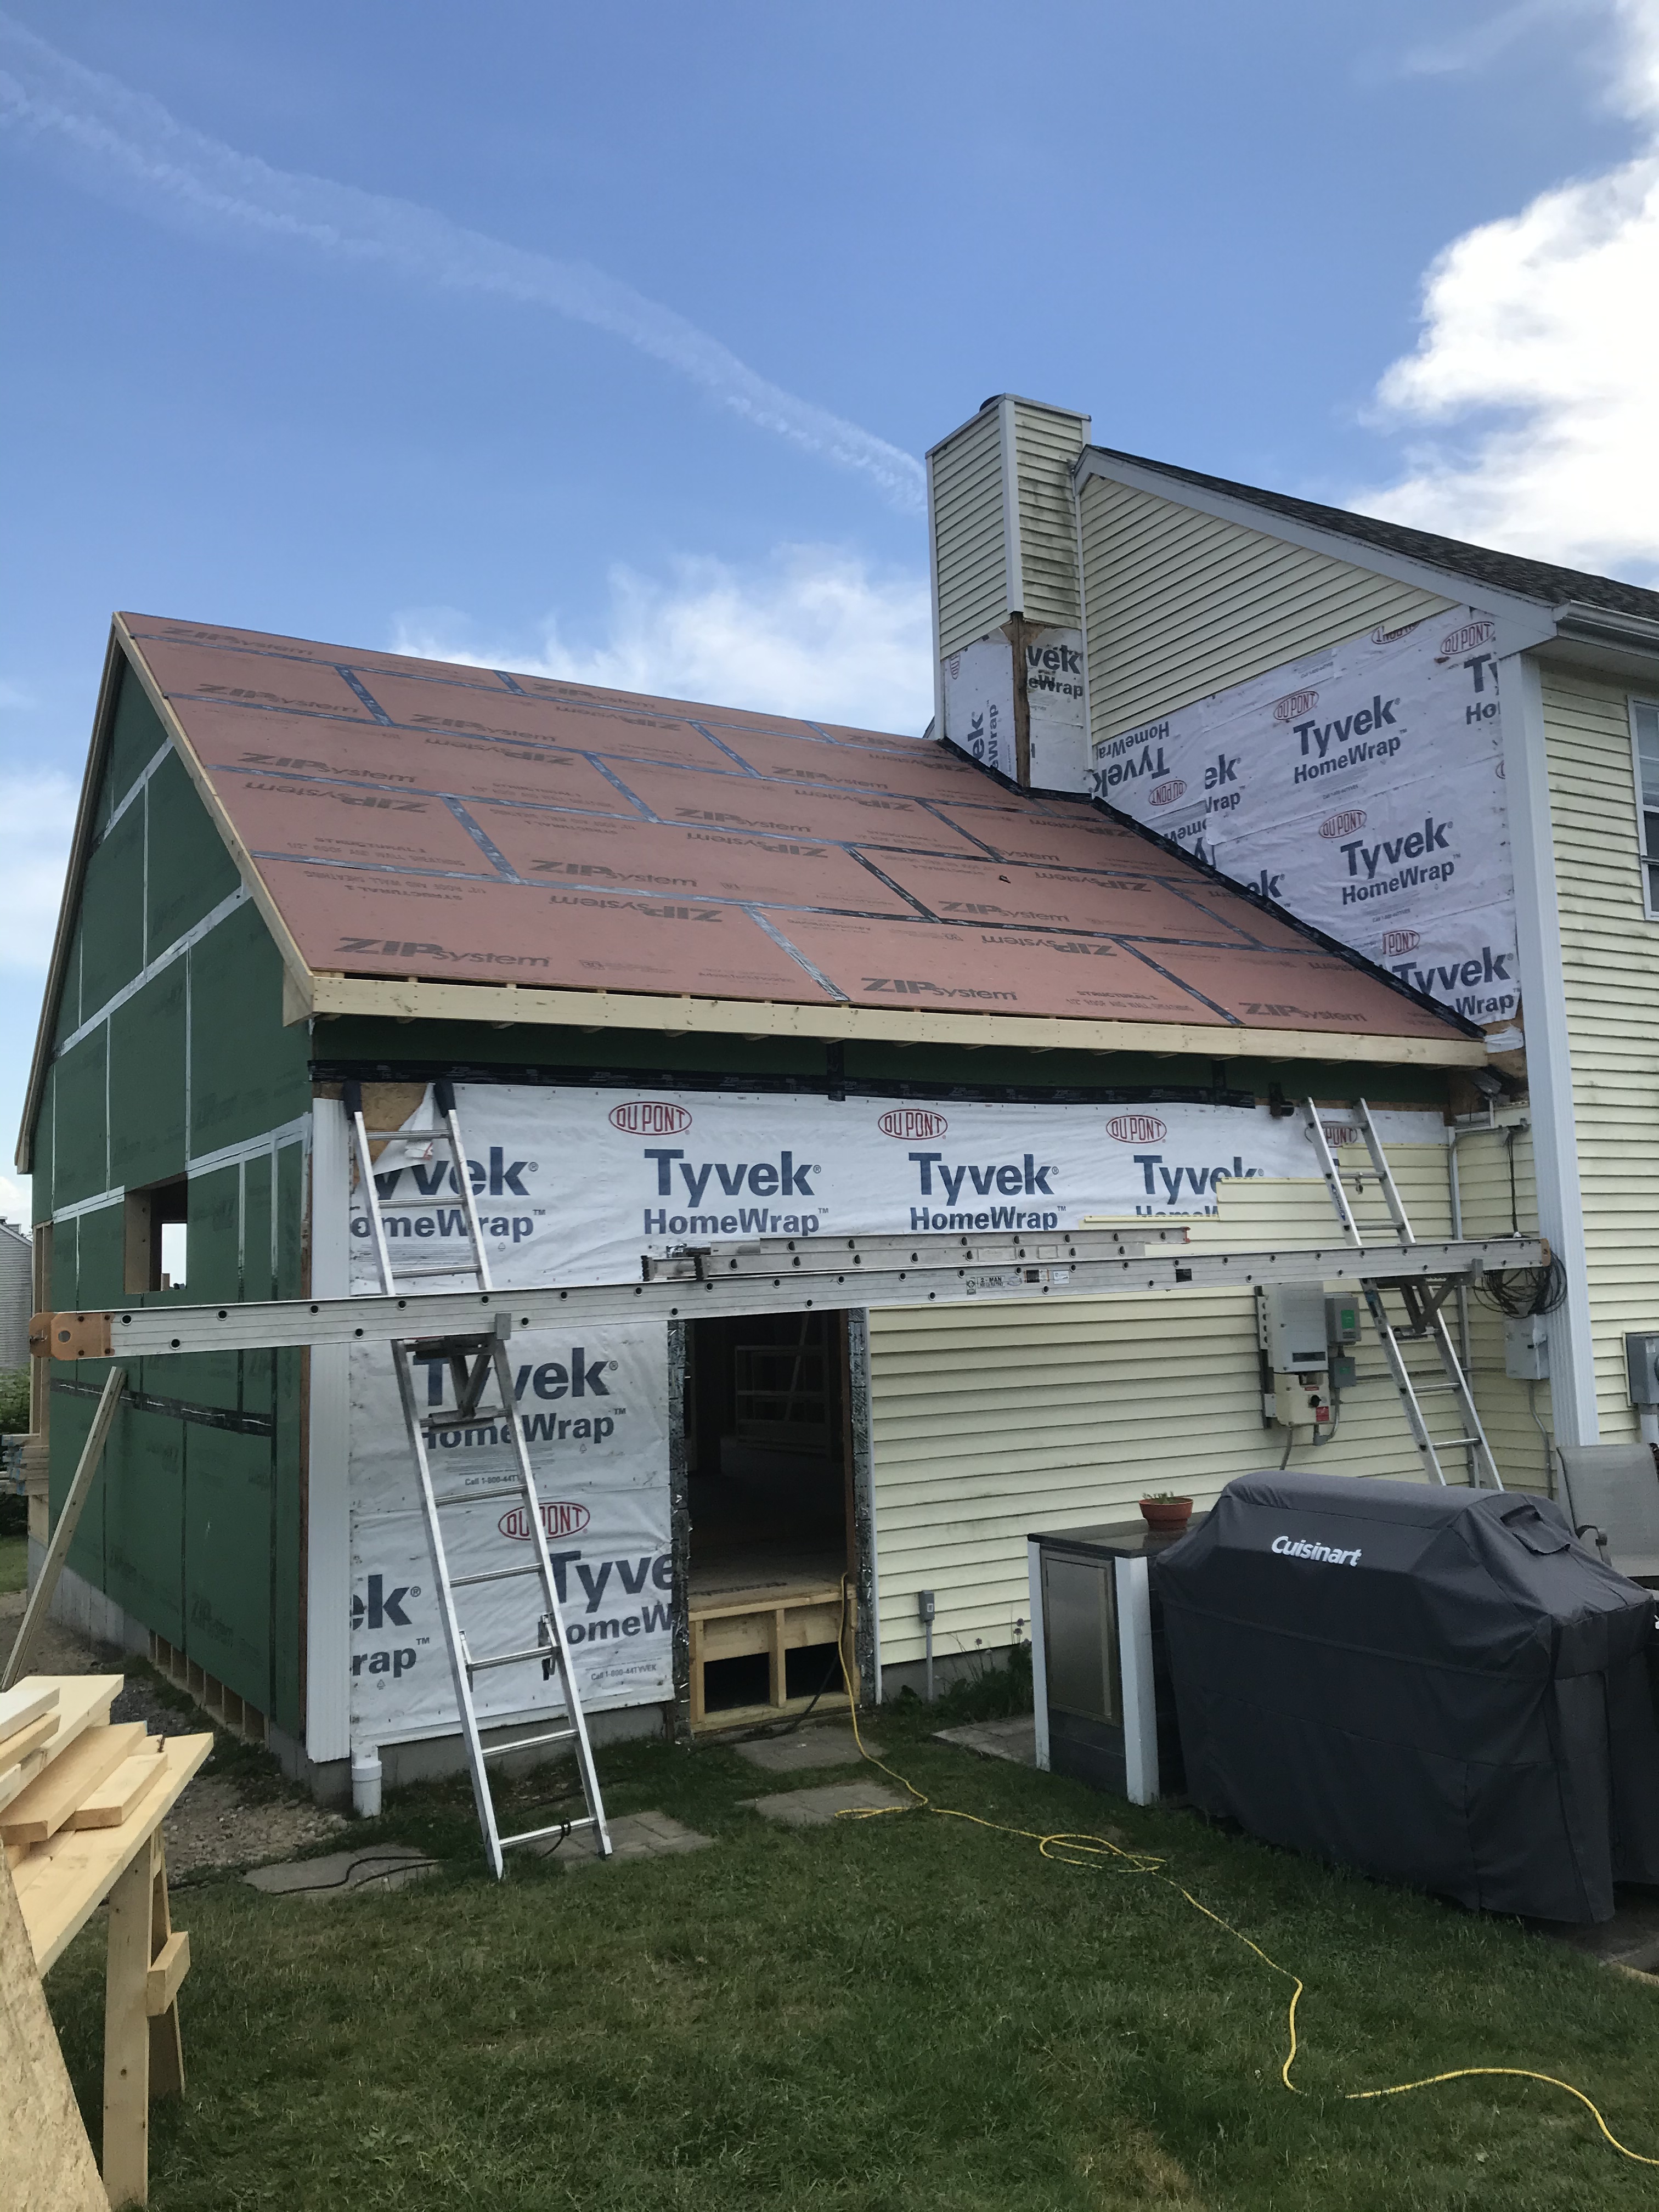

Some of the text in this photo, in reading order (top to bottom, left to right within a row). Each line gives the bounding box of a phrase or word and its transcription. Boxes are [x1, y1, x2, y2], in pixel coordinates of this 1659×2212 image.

[1294, 736, 1401, 784] HomeWrap
[1342, 860, 1455, 905] HomeWrap
[644, 1208, 820, 1236] HomeWrap
[910, 1206, 1058, 1231] HomeWrap
[1271, 1536, 1362, 1567] Cuisinart
